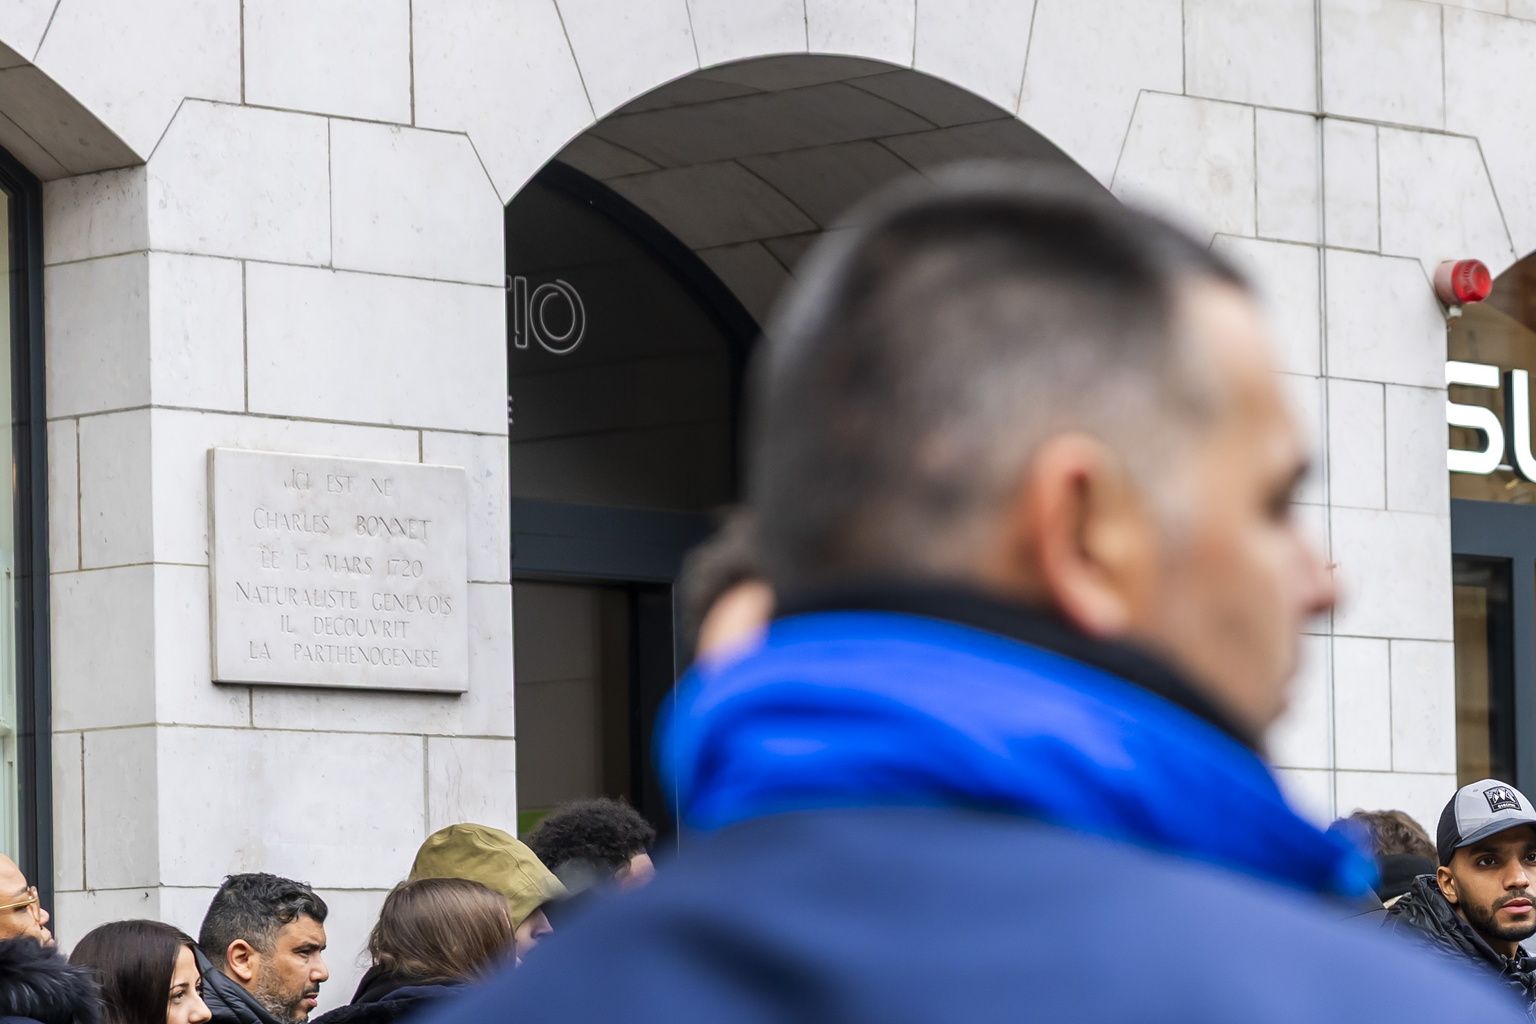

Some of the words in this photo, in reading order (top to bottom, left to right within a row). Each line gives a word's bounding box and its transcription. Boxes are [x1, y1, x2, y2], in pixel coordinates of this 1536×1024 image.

[326, 474, 355, 493] EST
[253, 507, 330, 534] CHARLES
[356, 515, 432, 541] BONNET
[261, 551, 280, 569] LE
[323, 555, 373, 575] MARS
[386, 559, 423, 578] 1720
[236, 581, 358, 609] NATURALISTE
[371, 592, 452, 615] GENEVOIS
[280, 615, 294, 633] IL
[250, 641, 271, 660] LA
